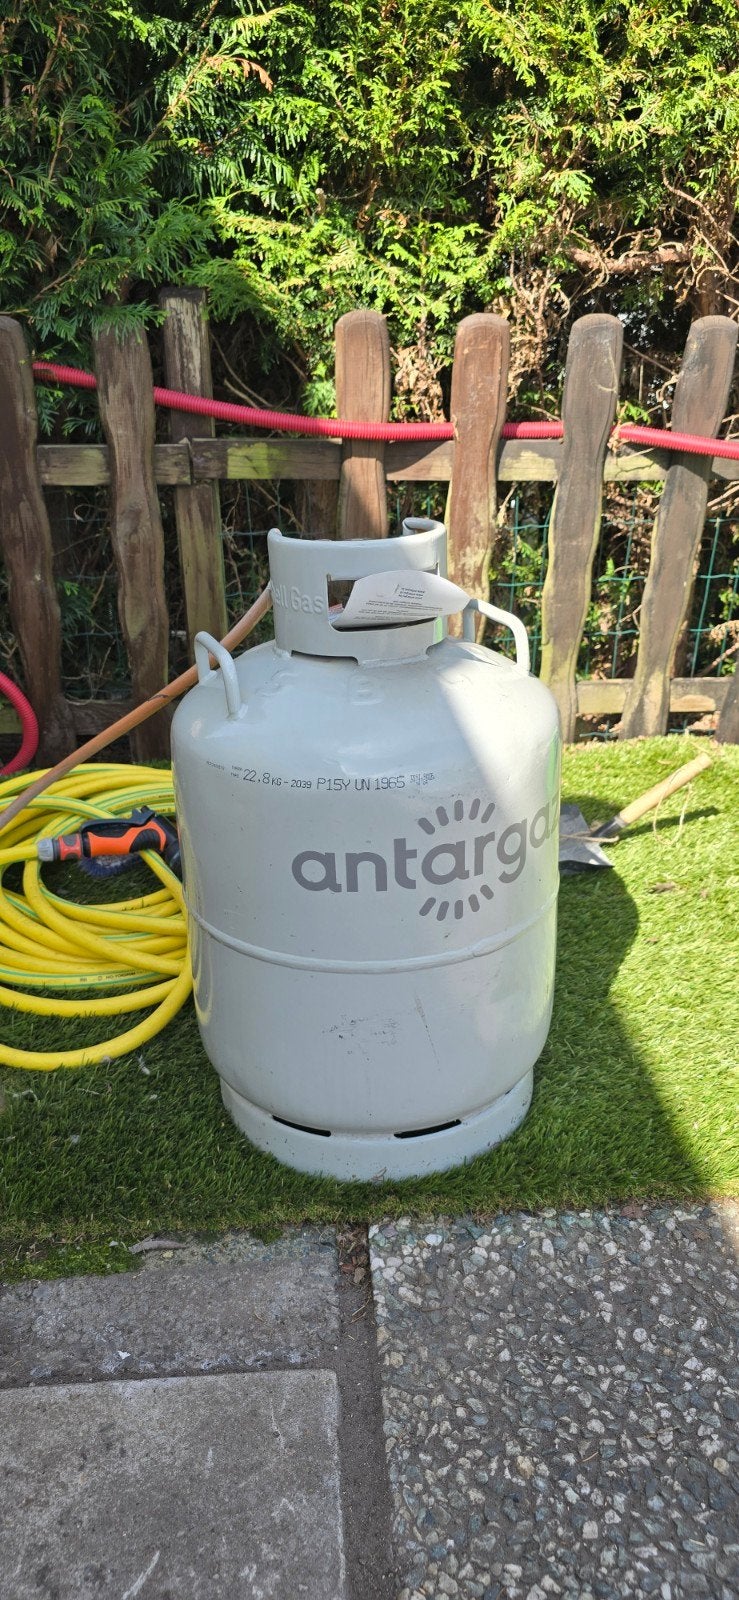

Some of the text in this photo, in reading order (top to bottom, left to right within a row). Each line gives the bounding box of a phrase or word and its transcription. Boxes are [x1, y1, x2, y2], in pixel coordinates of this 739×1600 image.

[290, 586, 324, 615] Gas
[290, 779, 312, 789] 2039
[316, 778, 351, 791] P15Y
[355, 778, 371, 791] UN
[375, 776, 406, 790] 1965
